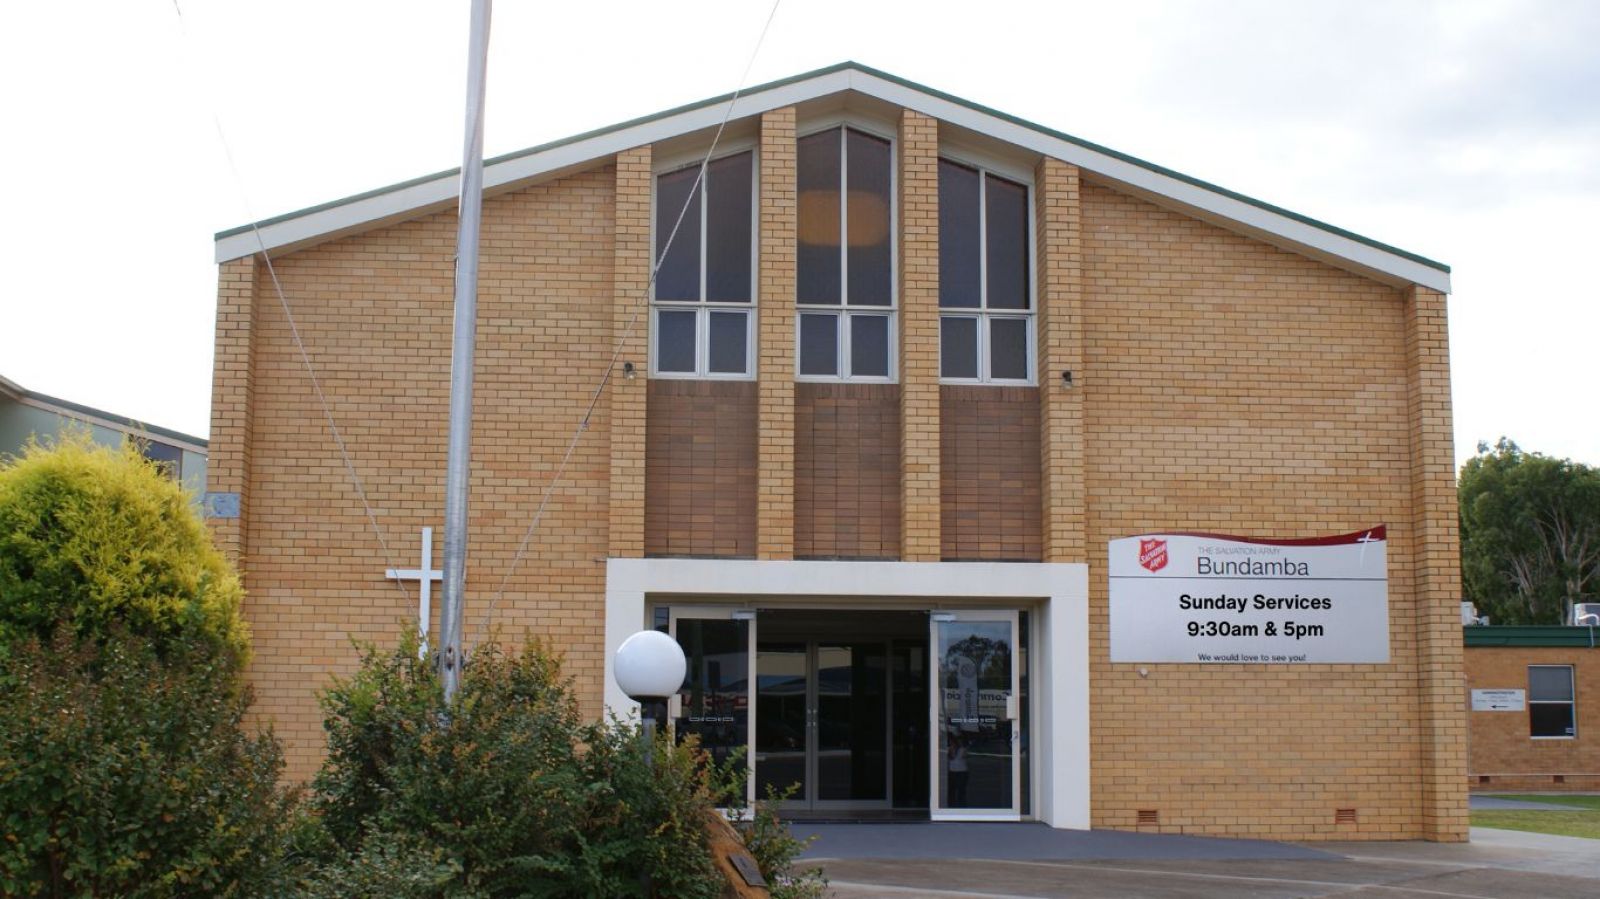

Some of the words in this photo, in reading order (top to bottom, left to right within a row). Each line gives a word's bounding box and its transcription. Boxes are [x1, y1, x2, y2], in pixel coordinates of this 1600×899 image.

[1198, 546, 1212, 555] THE
[1215, 546, 1257, 555] SALVATION
[1259, 547, 1281, 555] ARMY
[1197, 556, 1309, 576] Bundamba
[1179, 594, 1248, 613] Sunday
[1253, 594, 1332, 610] Services
[1187, 621, 1259, 637] 9:30am
[1264, 621, 1277, 637] &
[1284, 621, 1324, 640] 5pm
[1197, 653, 1211, 662] We
[1213, 653, 1239, 662] would
[1241, 653, 1258, 662] love
[1260, 653, 1269, 662] to
[1271, 654, 1287, 662] see
[1288, 653, 1306, 663] you!
